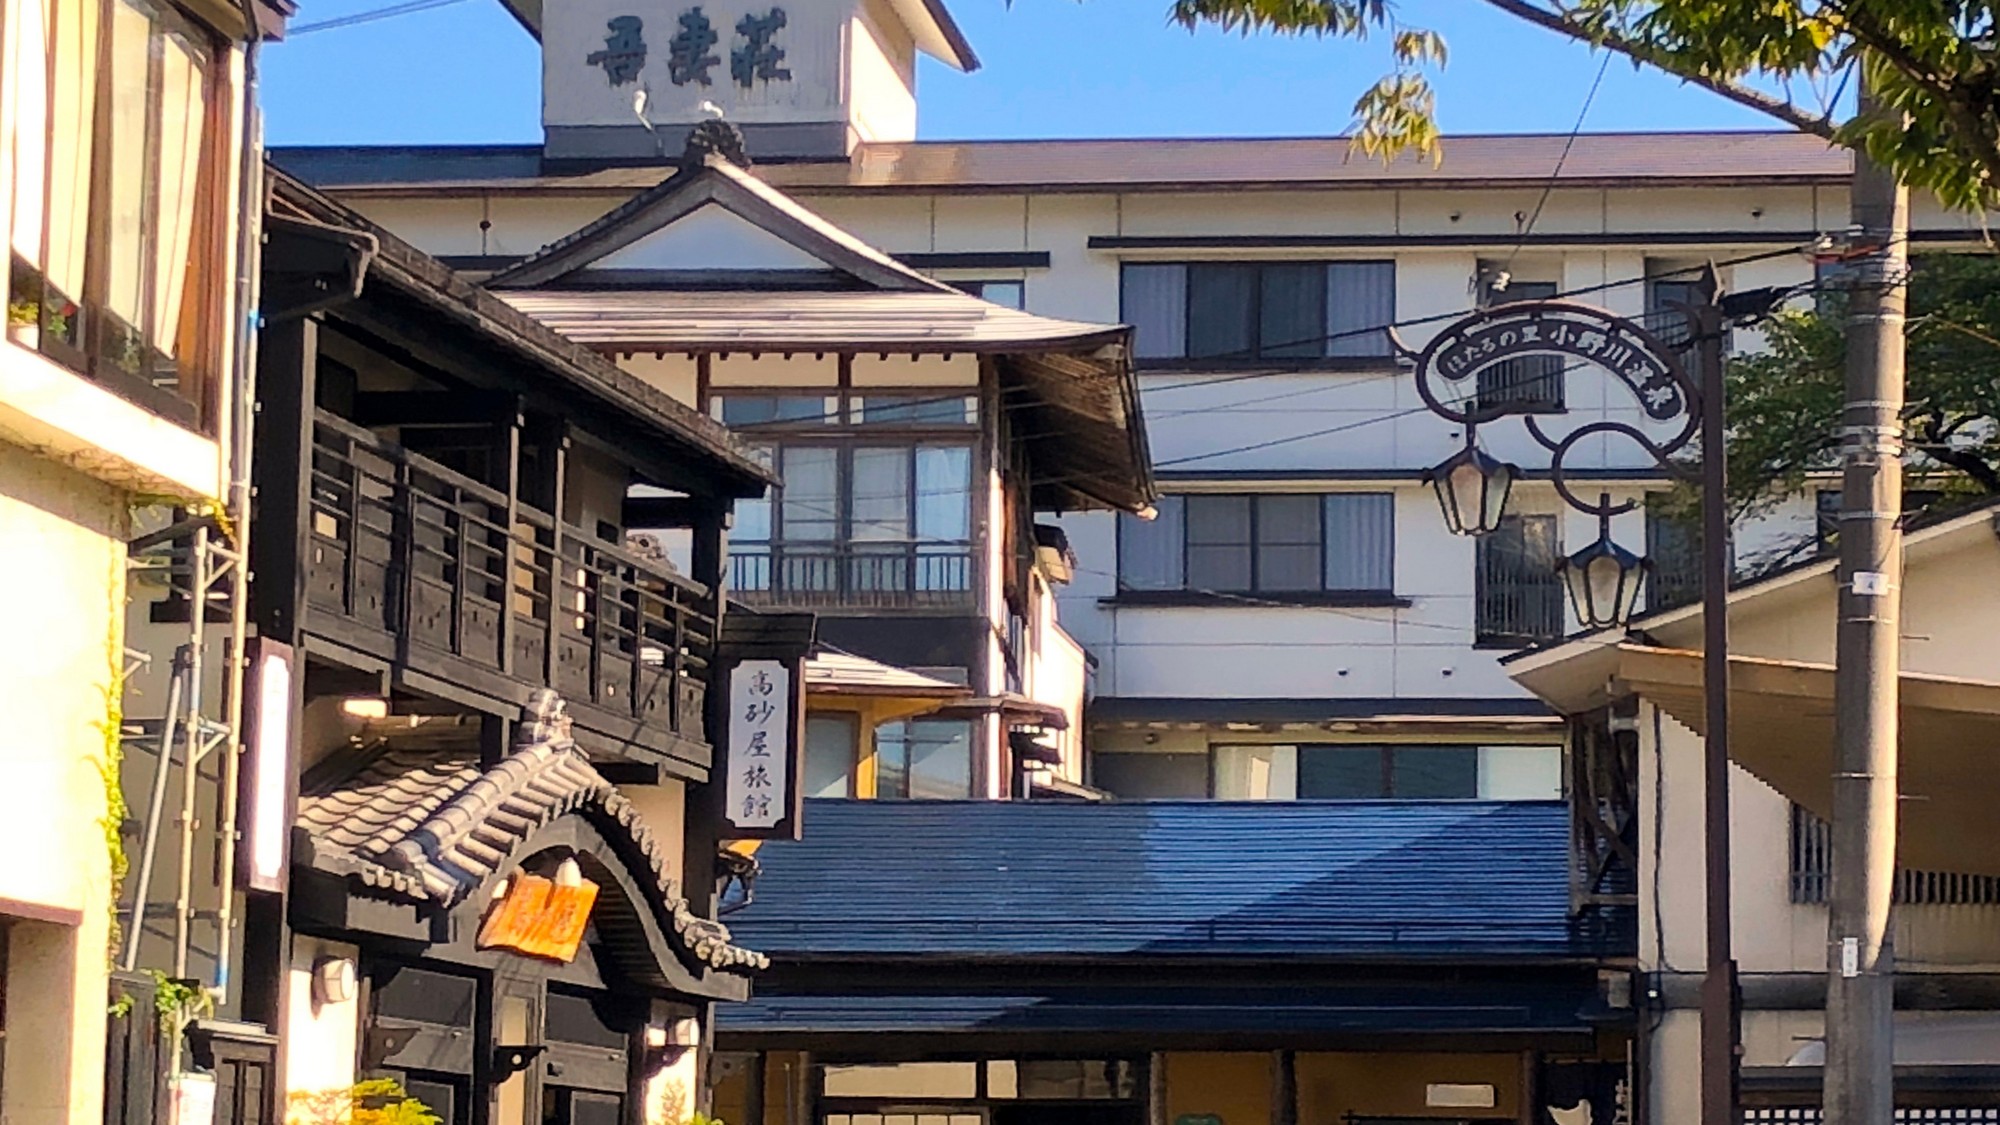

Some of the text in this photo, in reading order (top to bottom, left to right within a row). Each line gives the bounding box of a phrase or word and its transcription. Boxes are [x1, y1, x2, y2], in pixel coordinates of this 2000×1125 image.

[1549, 324, 1673, 410] 小野川温泉
[742, 670, 775, 819] 高砂屋旅館
